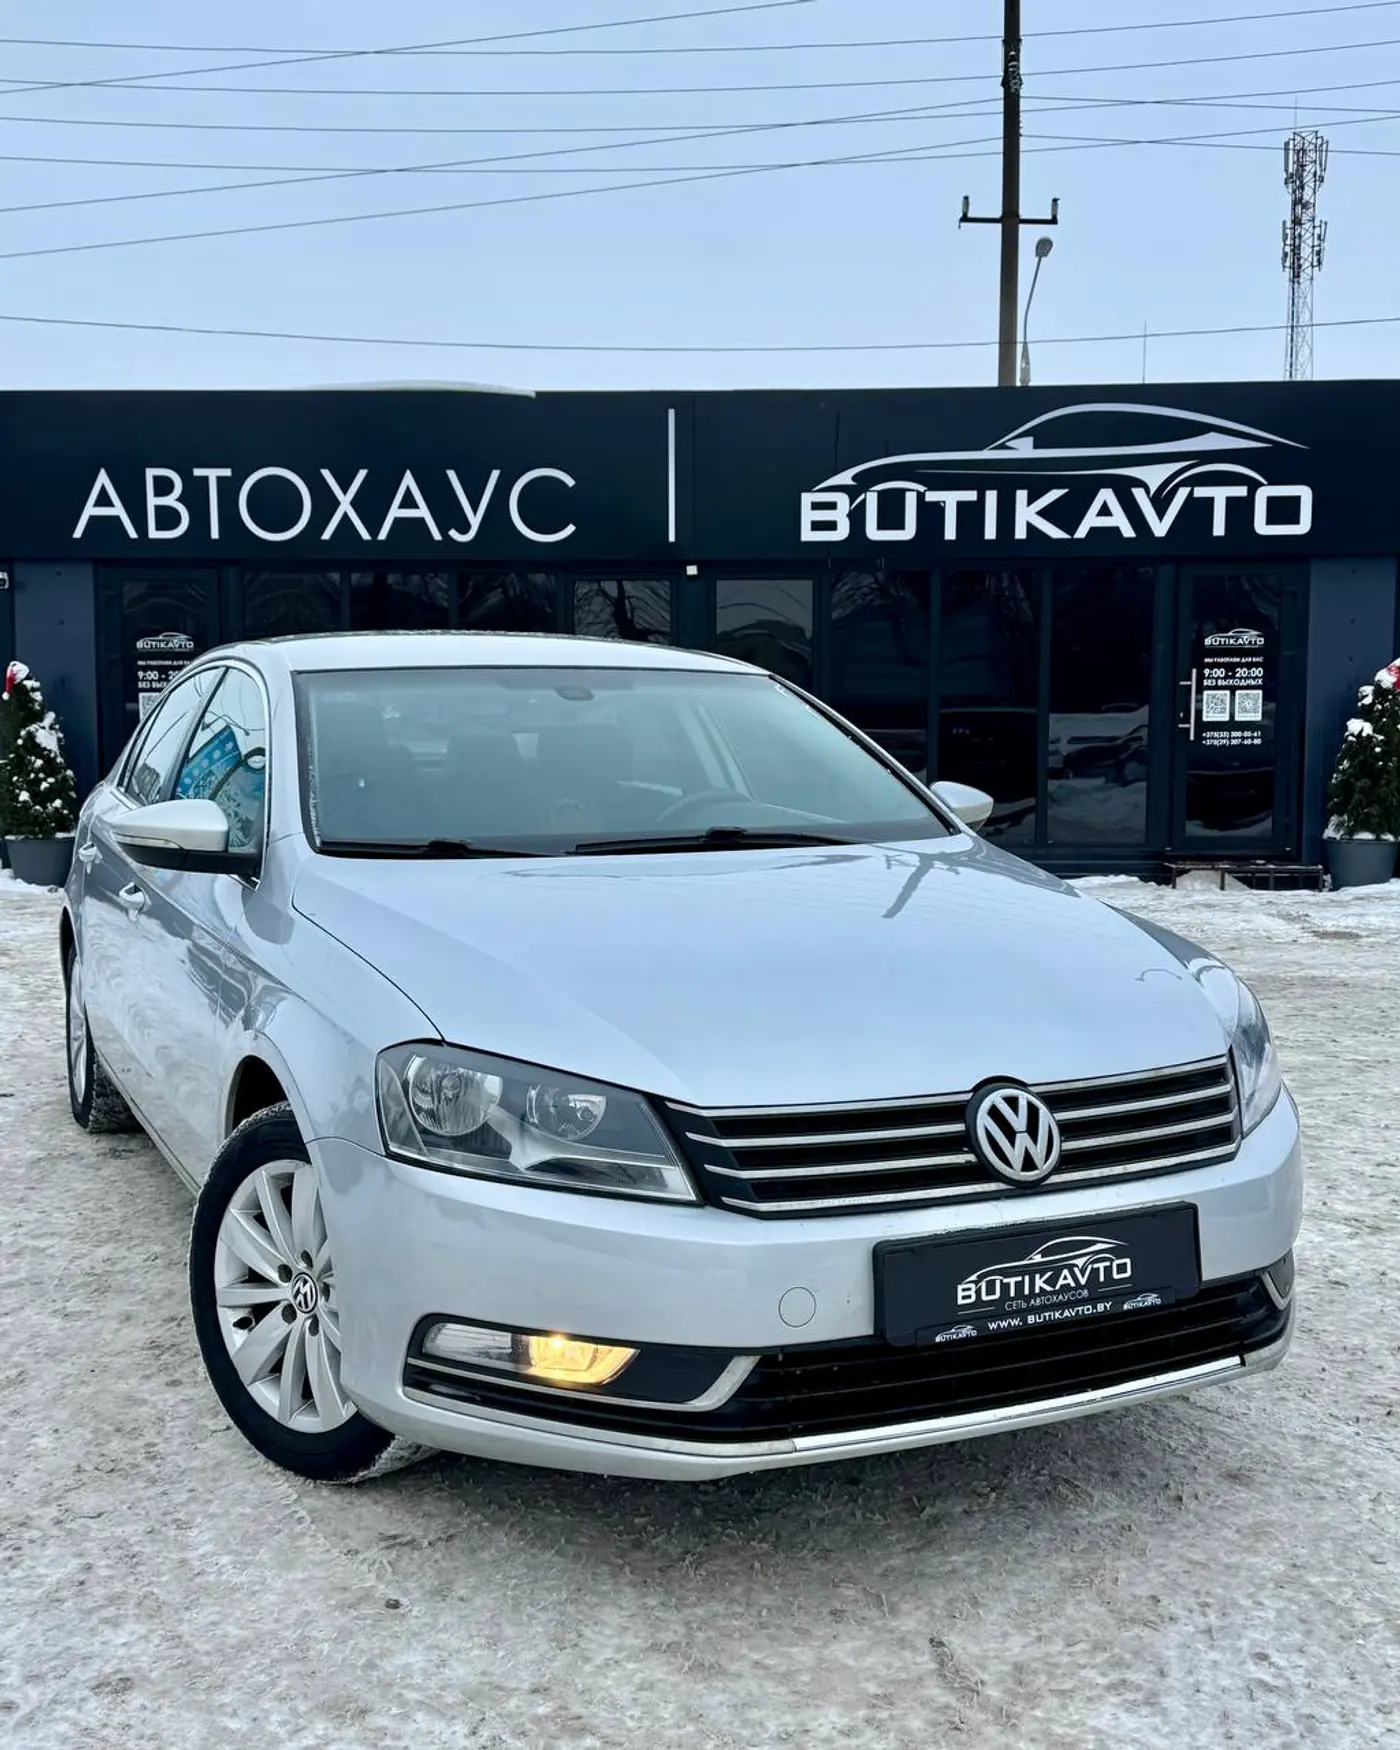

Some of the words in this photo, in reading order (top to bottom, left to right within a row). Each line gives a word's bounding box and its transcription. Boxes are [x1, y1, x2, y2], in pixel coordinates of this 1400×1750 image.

[72, 466, 577, 542] АВТОХАУС
[800, 484, 1313, 541] BUTIKAVTO
[1204, 637, 1264, 645] BUTIKAVTO
[138, 671, 158, 680] 9:00
[1204, 668, 1225, 677] 9:00
[1235, 667, 1263, 677] 20:00
[1203, 678, 1216, 686] БЕЗ
[1217, 678, 1263, 686] ВЫХОДНЫХ
[977, 1088, 1060, 1181] VW
[957, 1258, 1132, 1305] BUTIKAVTO
[1004, 1300, 1027, 1311] СЕТЬ
[1029, 1289, 1089, 1308] АВТОХАУСОВ
[1123, 1298, 1161, 1310] BUTIKAVTO
[988, 1317, 1022, 1331] WWW.
[1027, 1301, 1112, 1325] BUTIKAVTO.BY
[935, 1329, 977, 1342] BUTIKAVTO
